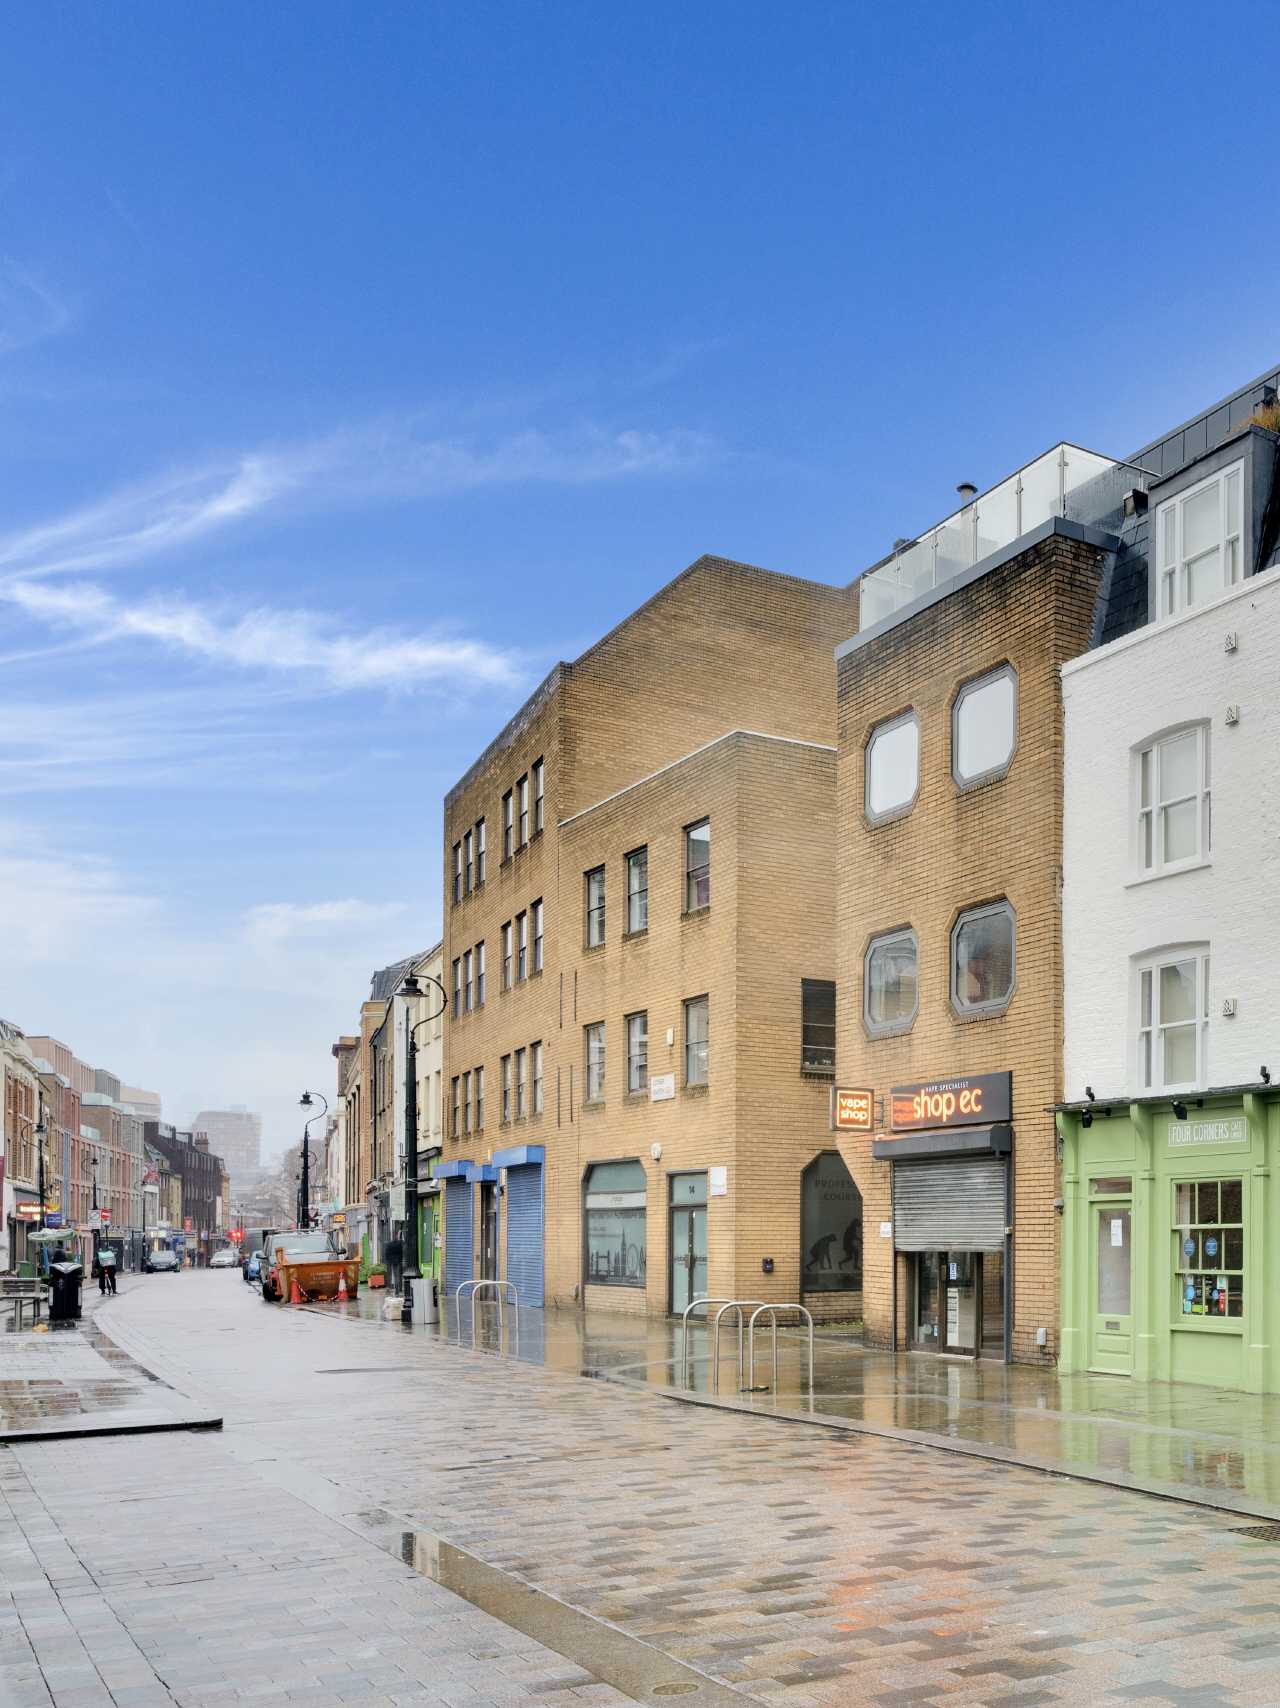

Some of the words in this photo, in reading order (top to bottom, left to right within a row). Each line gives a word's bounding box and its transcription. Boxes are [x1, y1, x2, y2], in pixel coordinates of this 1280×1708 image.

[939, 1081, 969, 1091] SPECIALIST
[840, 1097, 868, 1109] vape
[913, 1089, 956, 1122] shop
[959, 1088, 982, 1114] ec
[840, 1109, 868, 1121] shop
[1172, 1125, 1191, 1142] FOUR
[1193, 1122, 1229, 1141] CORNERS
[688, 1185, 695, 1194] 14
